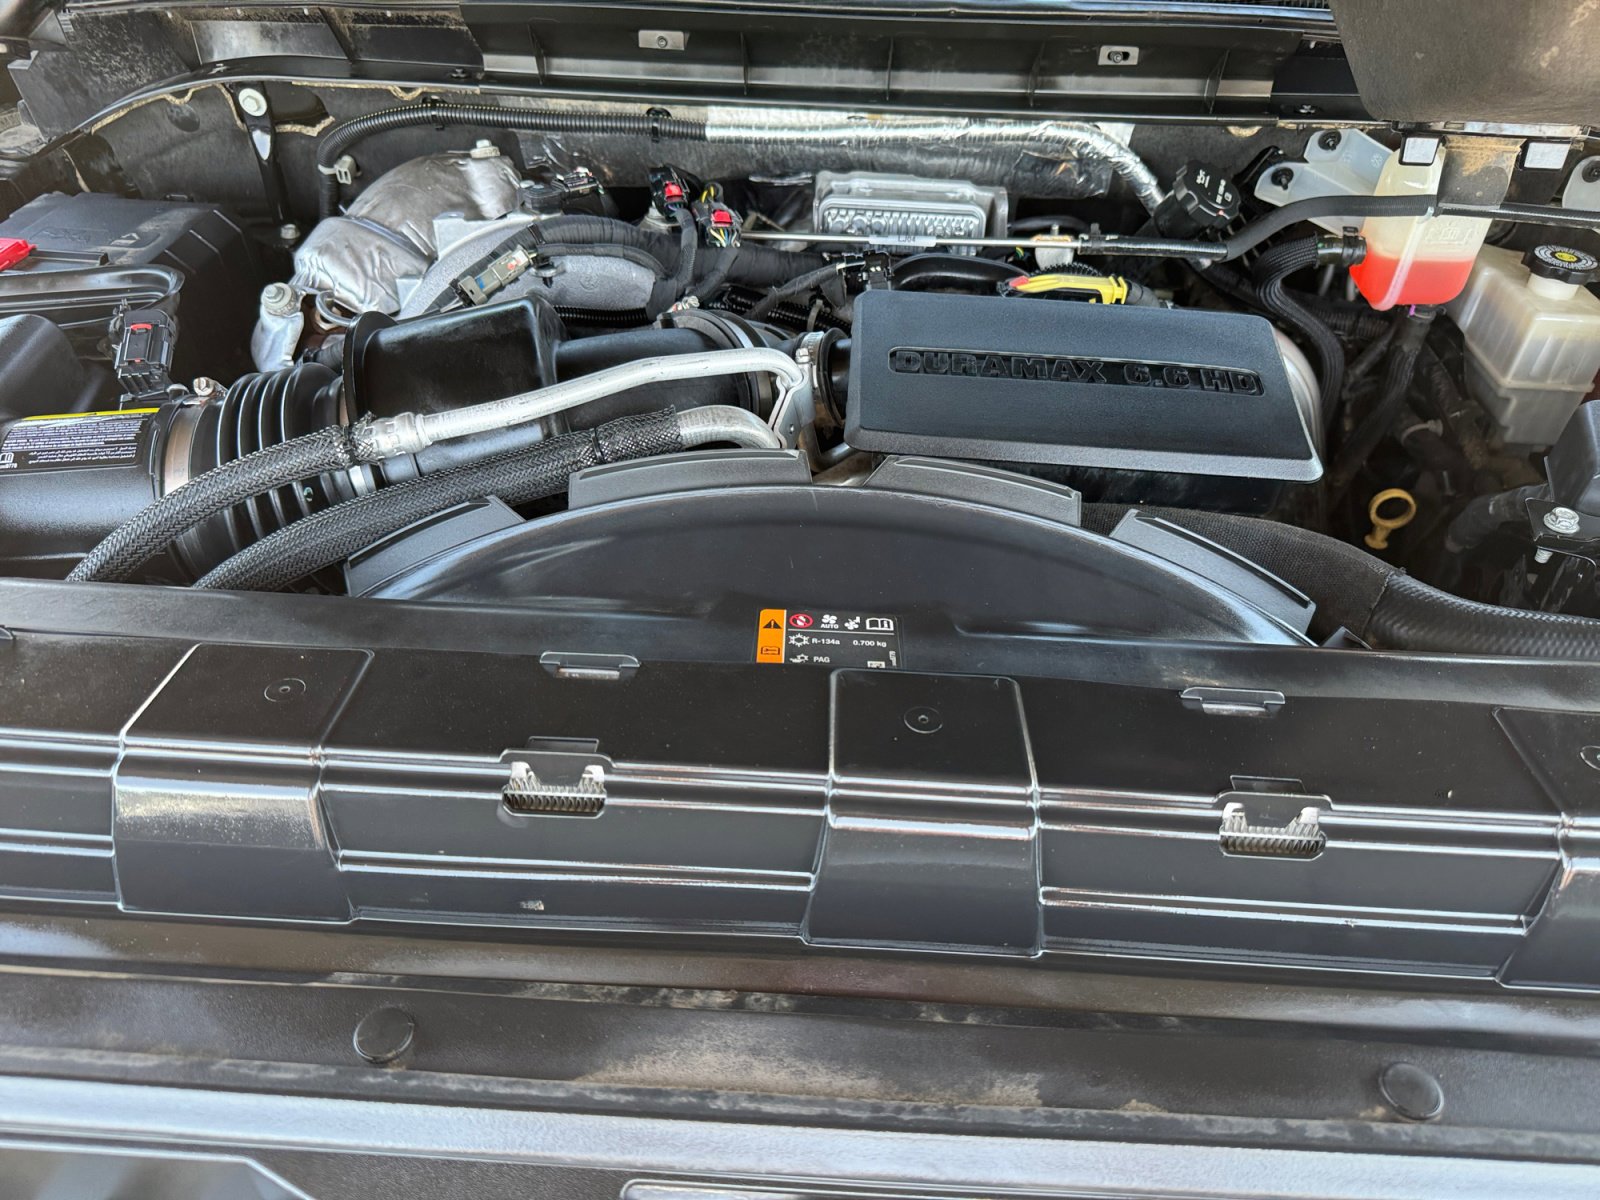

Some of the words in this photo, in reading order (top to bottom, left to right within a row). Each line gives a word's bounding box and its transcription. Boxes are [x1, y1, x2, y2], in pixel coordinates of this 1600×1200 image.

[895, 351, 1107, 383] DURAMAX
[1123, 364, 1191, 388] 6.6
[1201, 369, 1258, 394] HD
[811, 637, 841, 646] R-134a
[852, 639, 876, 647] 0.700
[813, 656, 831, 664] PAG
